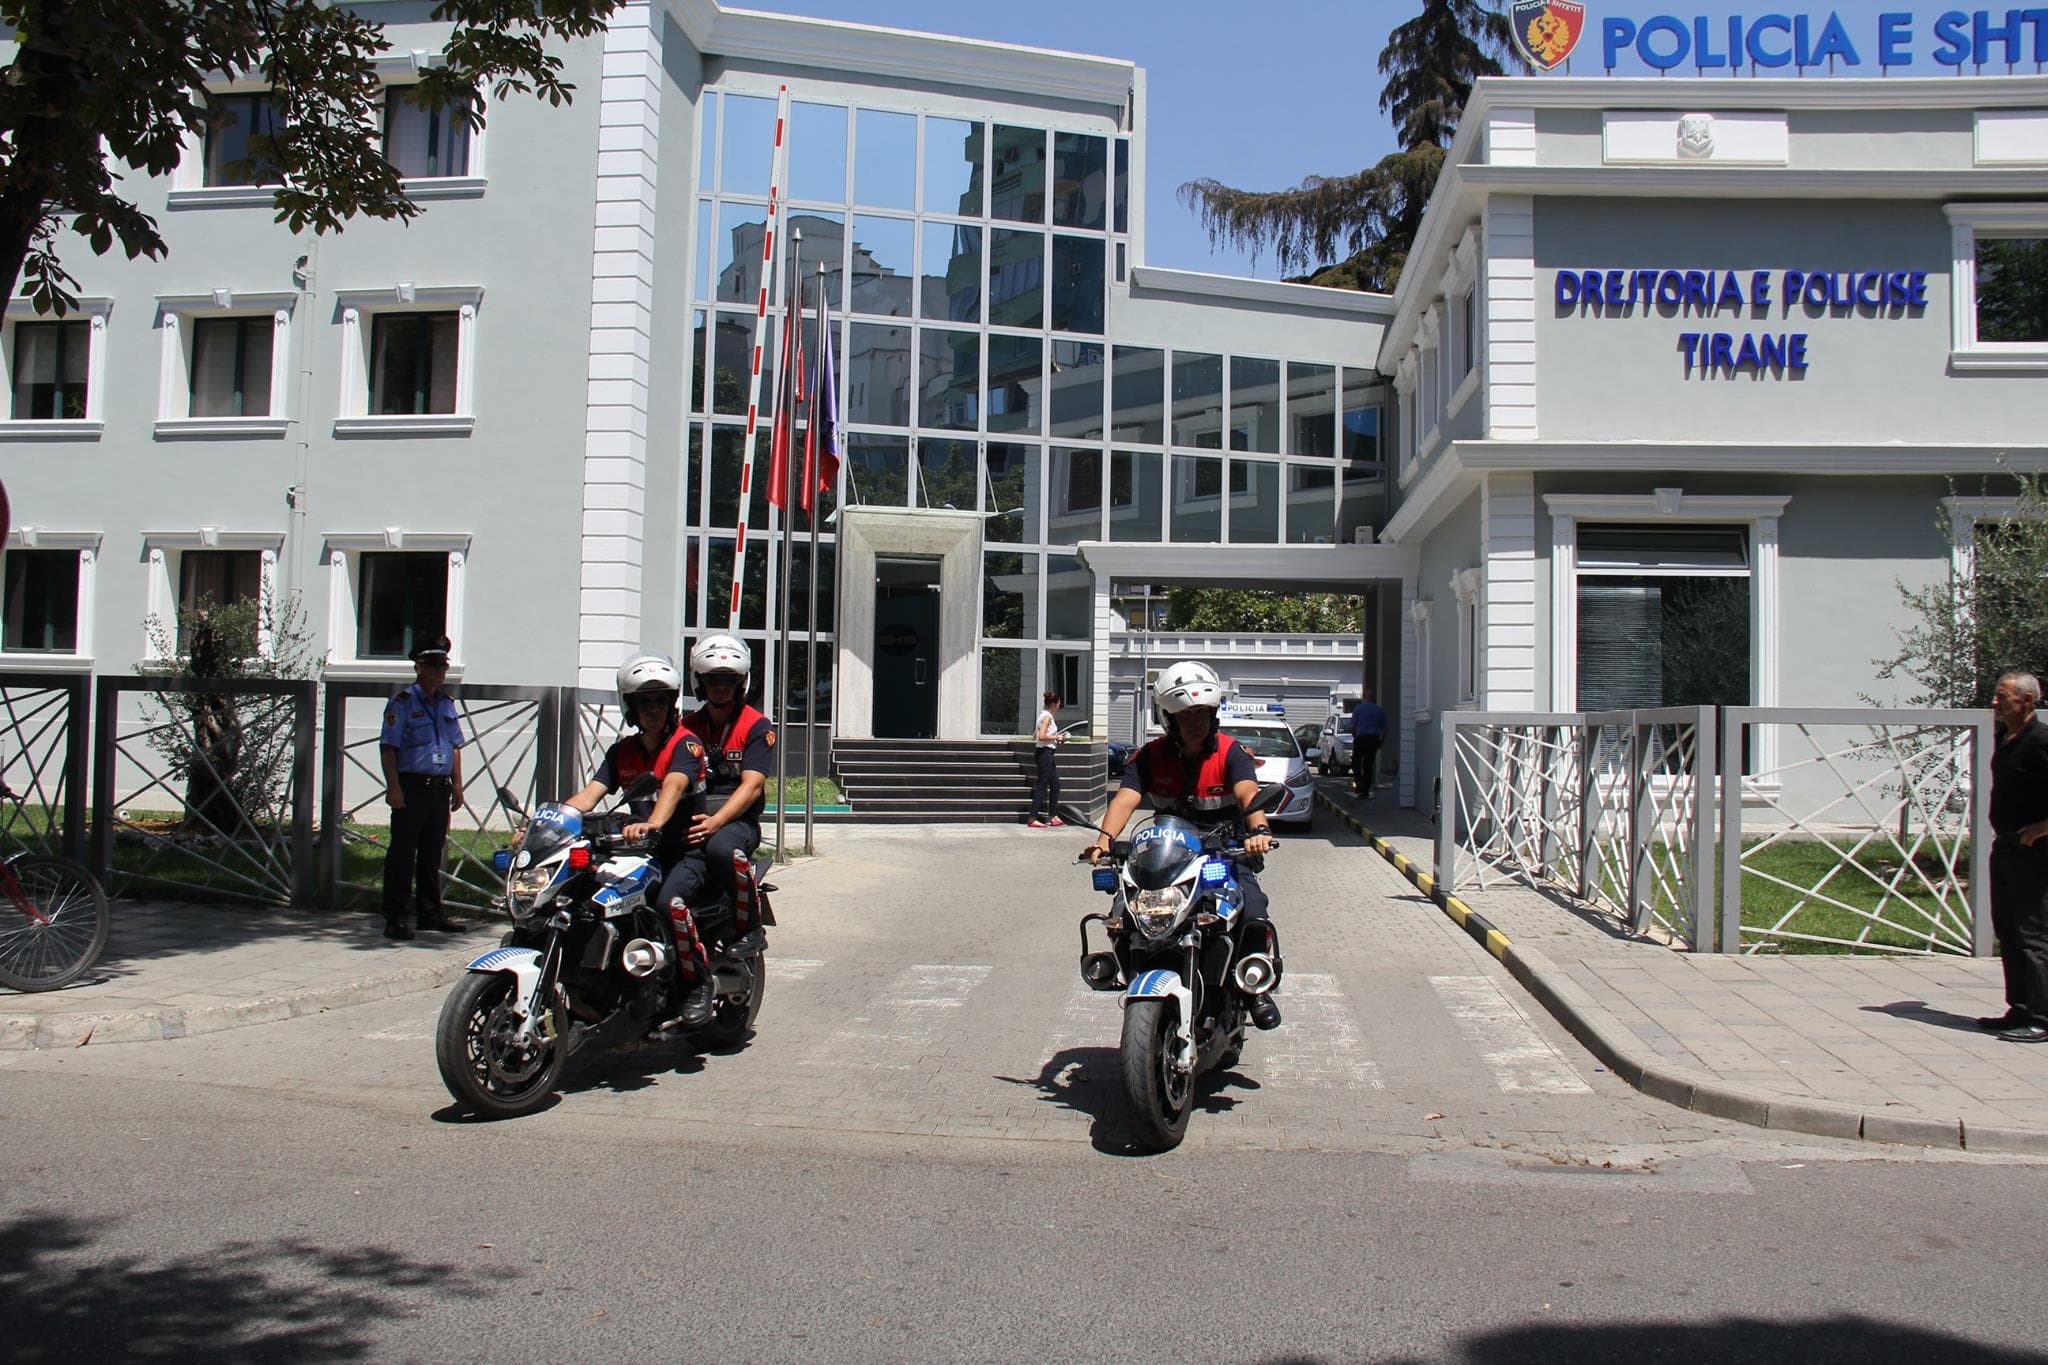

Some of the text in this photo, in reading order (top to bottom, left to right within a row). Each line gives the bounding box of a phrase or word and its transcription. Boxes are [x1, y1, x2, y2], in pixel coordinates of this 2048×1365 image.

[1603, 8, 2048, 69] POLICIA E SHT
[1556, 270, 1929, 305] DREJTORIA E POLICISE
[1679, 333, 1809, 368] TIRANE
[1228, 704, 1265, 712] POLICIA
[1135, 828, 1186, 844] POLICIA
